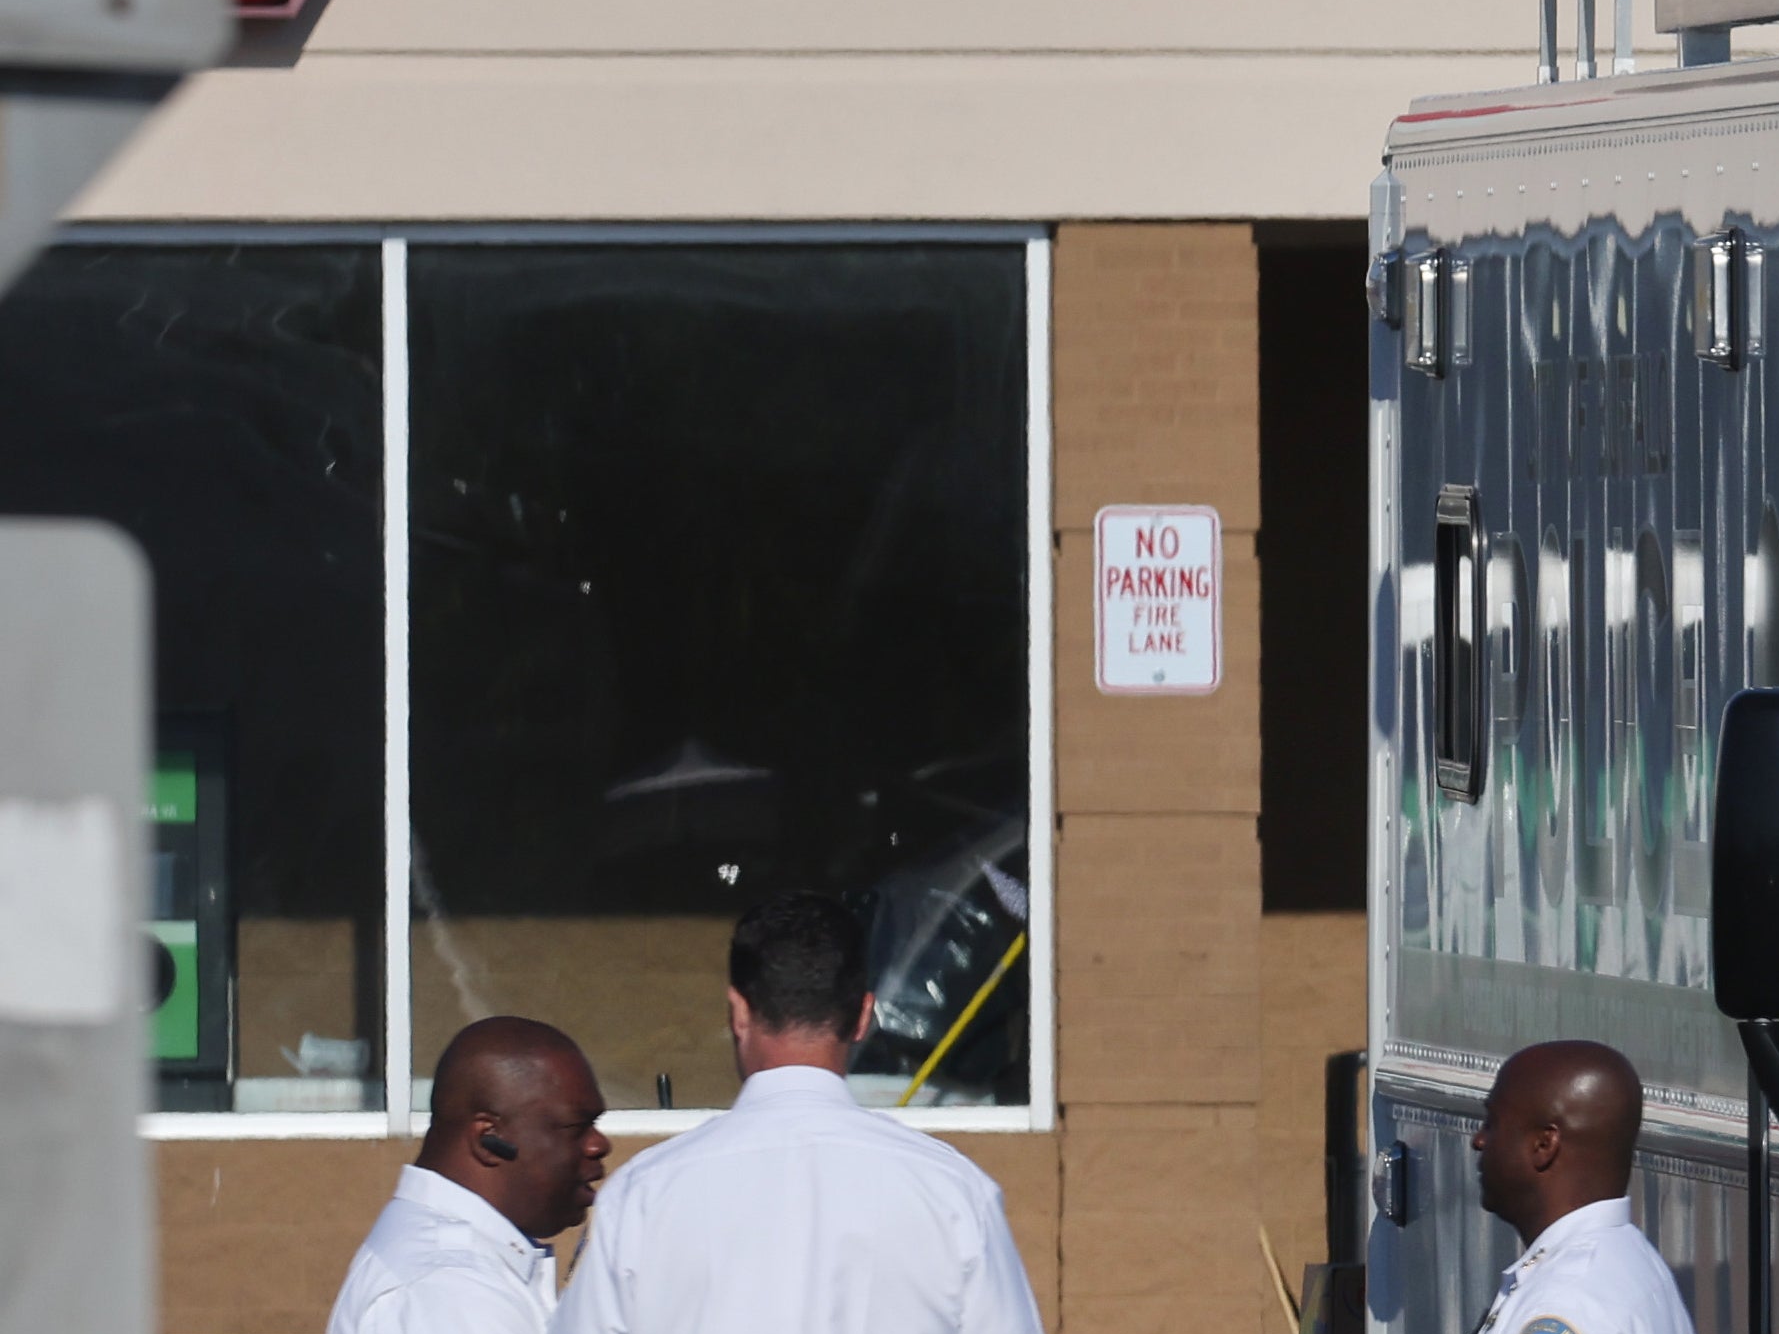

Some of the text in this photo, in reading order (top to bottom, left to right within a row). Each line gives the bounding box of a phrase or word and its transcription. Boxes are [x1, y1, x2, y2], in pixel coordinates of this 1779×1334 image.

[1135, 525, 1180, 560] NO
[1106, 566, 1210, 599] PARKING
[1133, 604, 1181, 627] FIRE
[1128, 631, 1186, 654] LANE
